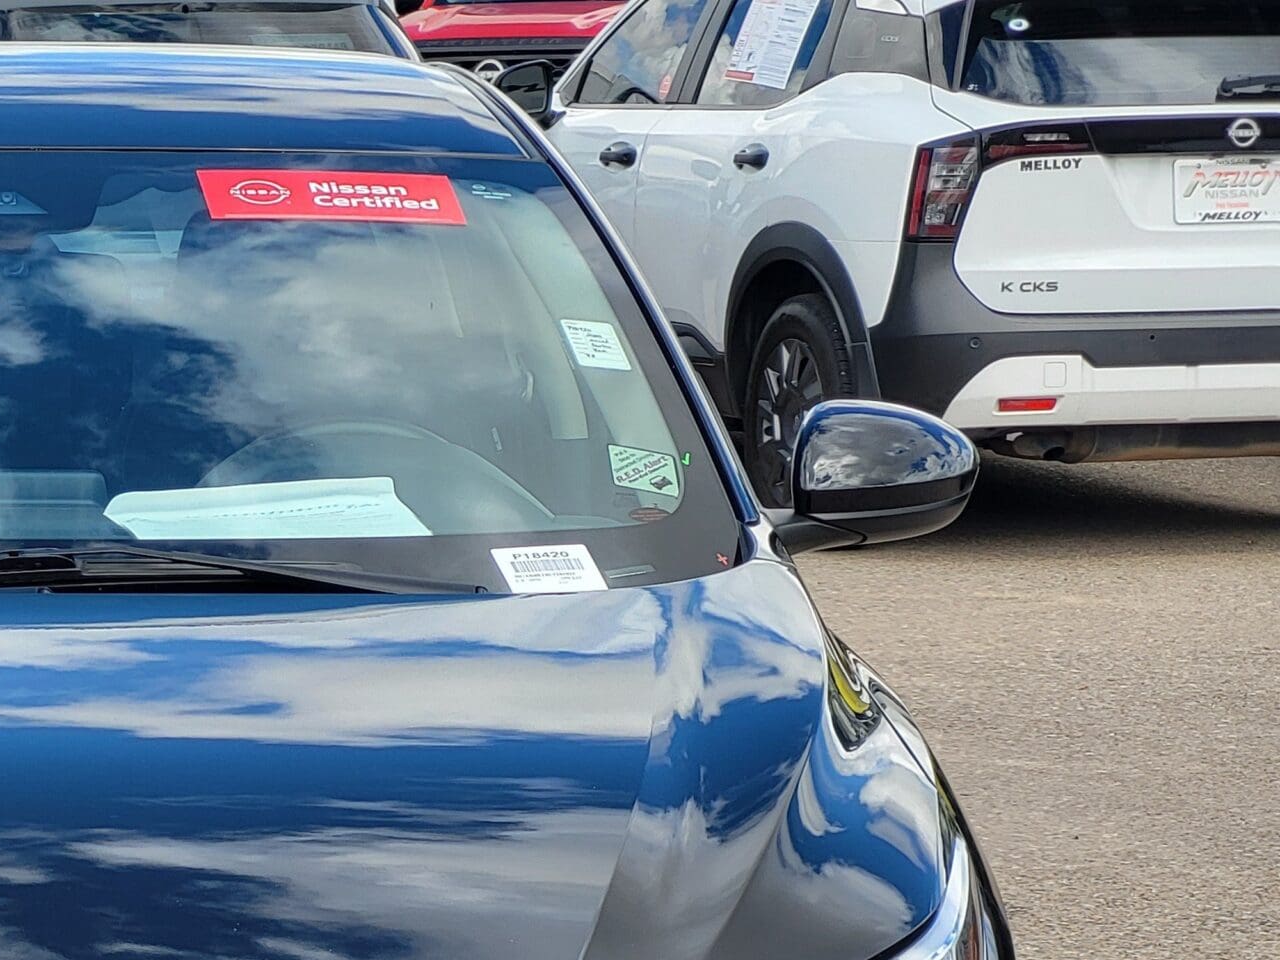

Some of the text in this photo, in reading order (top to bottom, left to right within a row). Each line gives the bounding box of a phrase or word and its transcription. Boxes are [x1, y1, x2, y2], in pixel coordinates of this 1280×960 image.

[1020, 158, 1082, 171] MELLOY
[308, 181, 407, 196] Nissan
[1204, 188, 1259, 199] NISSAN
[313, 195, 440, 210] Certified
[1200, 211, 1261, 221] MELLOY
